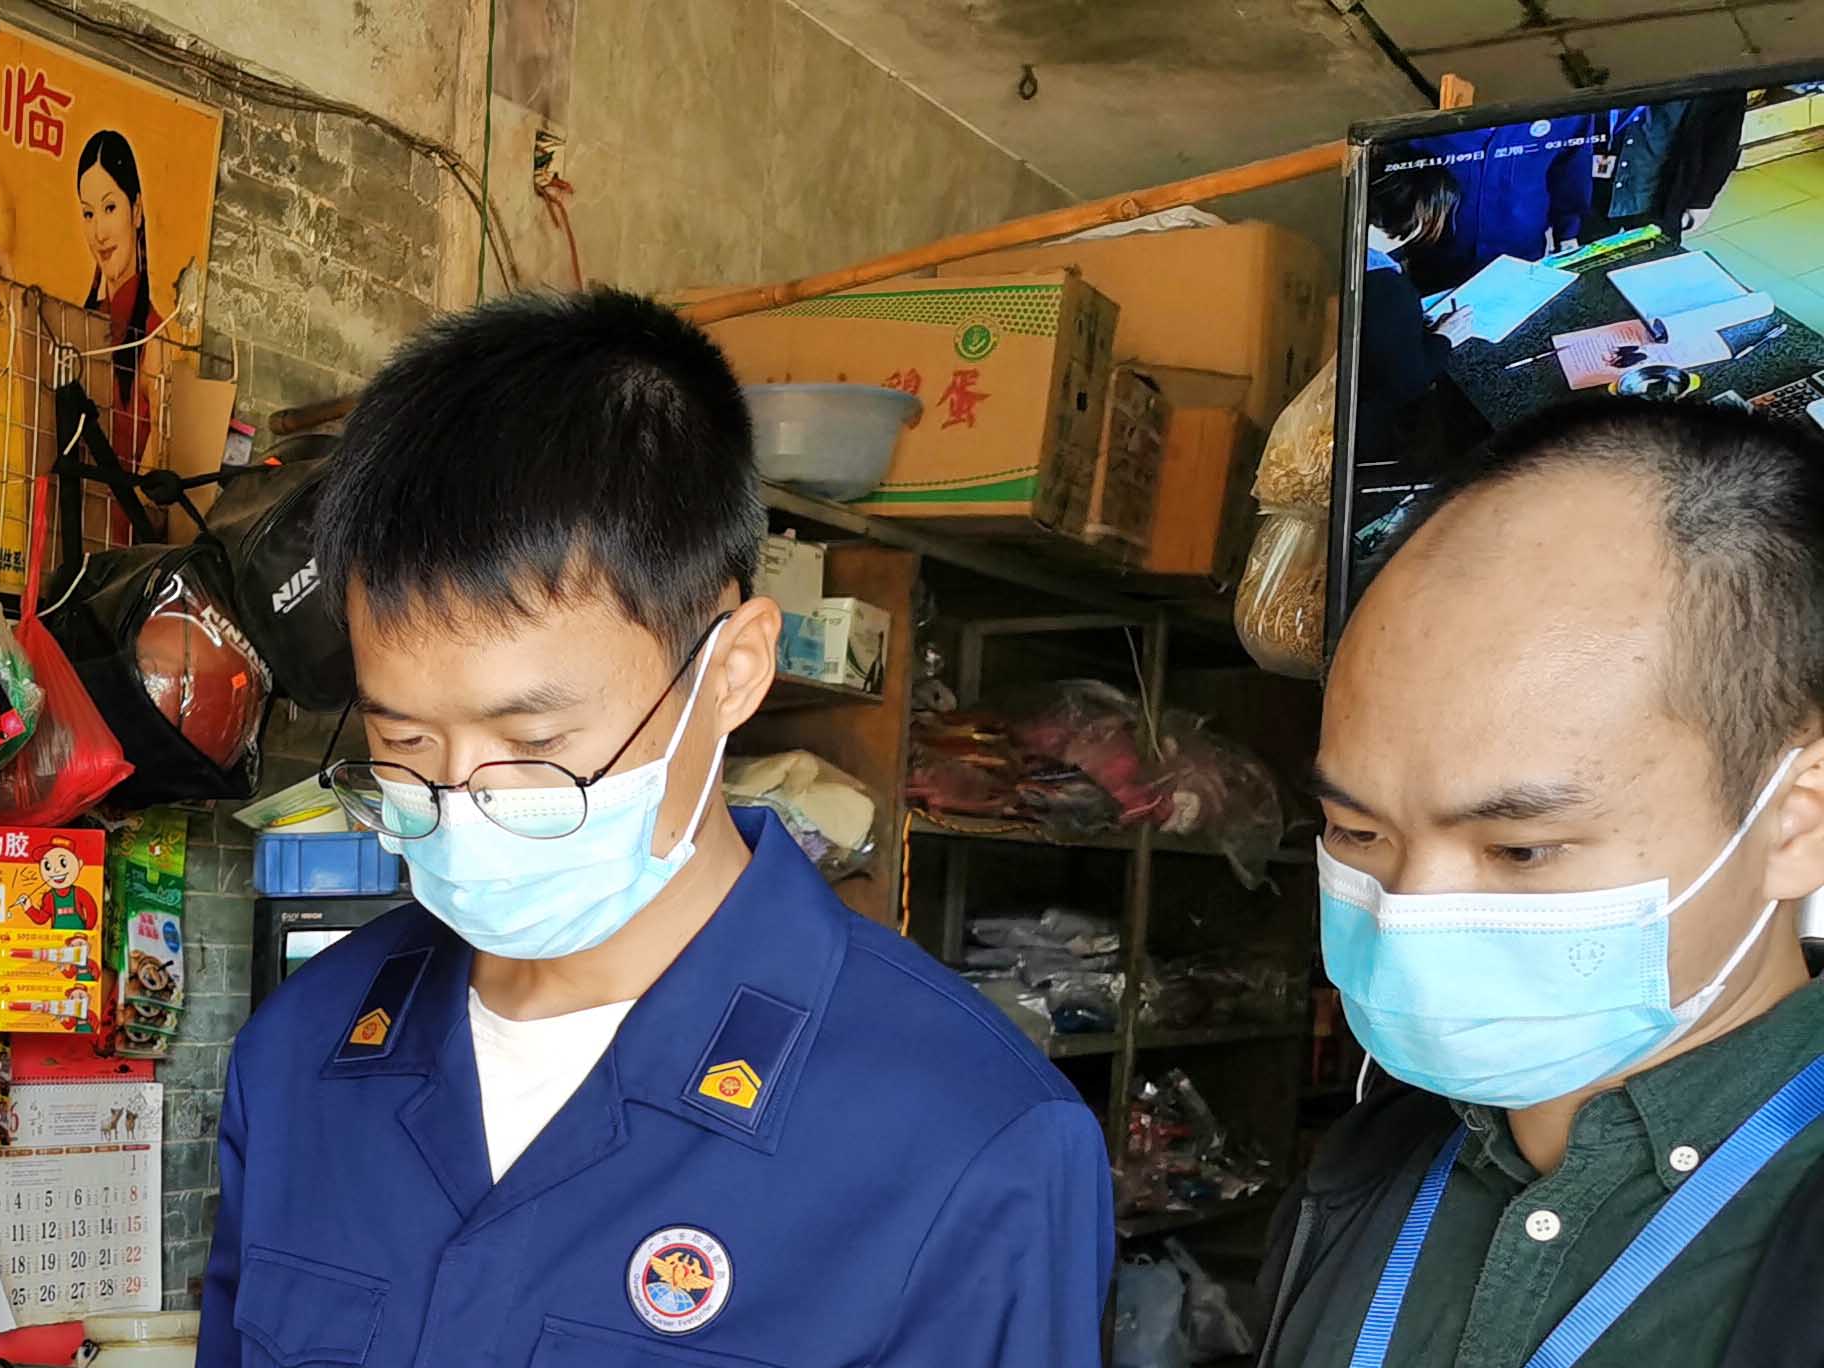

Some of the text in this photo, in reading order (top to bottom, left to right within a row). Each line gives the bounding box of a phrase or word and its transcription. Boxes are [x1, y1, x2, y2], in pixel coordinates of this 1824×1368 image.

[13, 1192, 22, 1209] 4
[44, 1190, 53, 1207] 5
[74, 1188, 83, 1205] 6
[103, 1187, 110, 1203] 7
[129, 1186, 138, 1201] 8
[12, 1225, 25, 1242] 11
[41, 1222, 57, 1239] 12
[71, 1220, 86, 1237] 13
[100, 1218, 112, 1234] 14
[127, 1216, 141, 1232] 15
[11, 1256, 26, 1274] 18
[41, 1253, 56, 1270] 19
[71, 1251, 86, 1268] 20
[99, 1249, 112, 1265] 21
[126, 1246, 141, 1262] 22
[11, 1288, 26, 1305] 25
[40, 1285, 56, 1302] 26
[71, 1282, 86, 1299] 27
[99, 1279, 114, 1296] 28
[126, 1276, 141, 1292] 29
